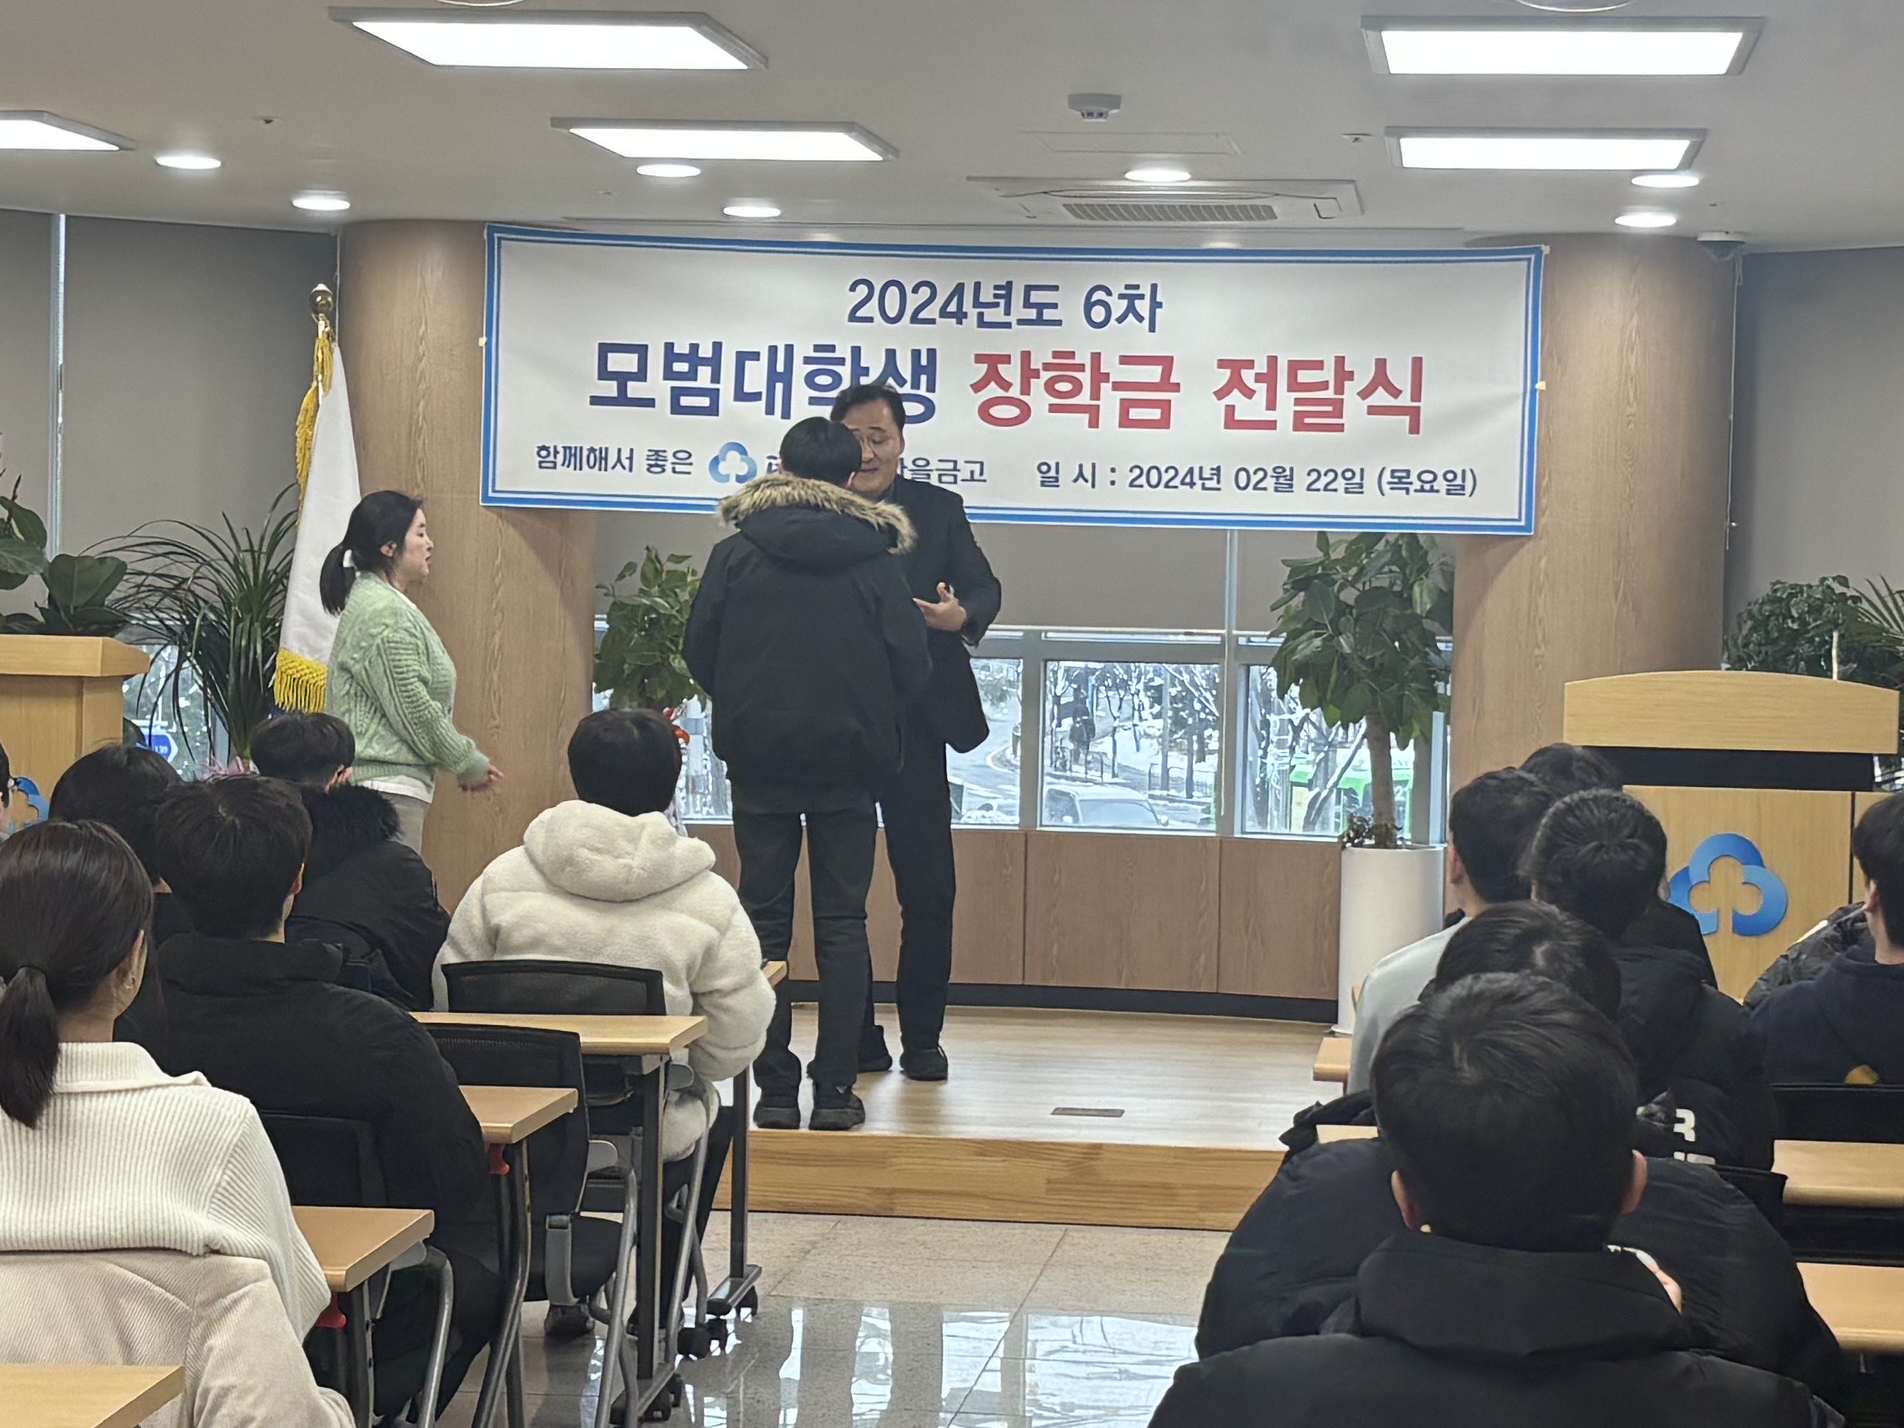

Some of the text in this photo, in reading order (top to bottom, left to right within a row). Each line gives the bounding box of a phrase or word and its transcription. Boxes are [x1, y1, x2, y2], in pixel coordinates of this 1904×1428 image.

[847, 278, 1164, 333] 2024년도 6차
[588, 340, 1424, 436] 모범대학생 장학금 전달식
[535, 444, 635, 473] 함께해서
[645, 448, 694, 476] 좋은
[1128, 464, 1223, 492] 2024년
[1233, 465, 1295, 493] 02월
[1306, 467, 1366, 495] 22일
[1376, 467, 1478, 498] (목요일)
